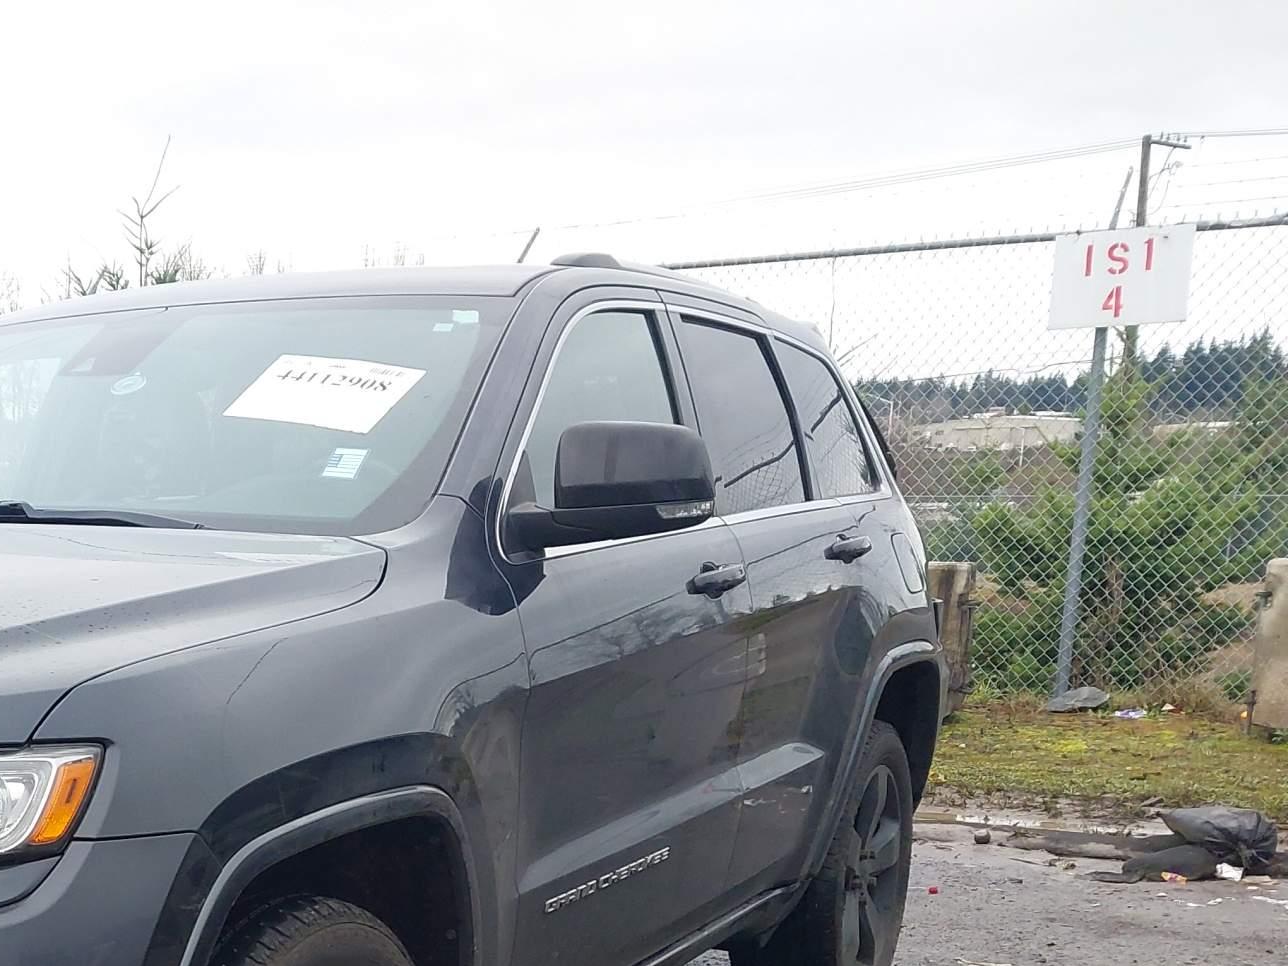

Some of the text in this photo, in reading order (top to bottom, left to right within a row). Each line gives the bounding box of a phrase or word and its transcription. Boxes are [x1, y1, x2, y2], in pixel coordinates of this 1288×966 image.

[1102, 285, 1124, 318] 4
[277, 368, 392, 392] 44112908
[545, 847, 670, 912] GRAND CHEROKEE
